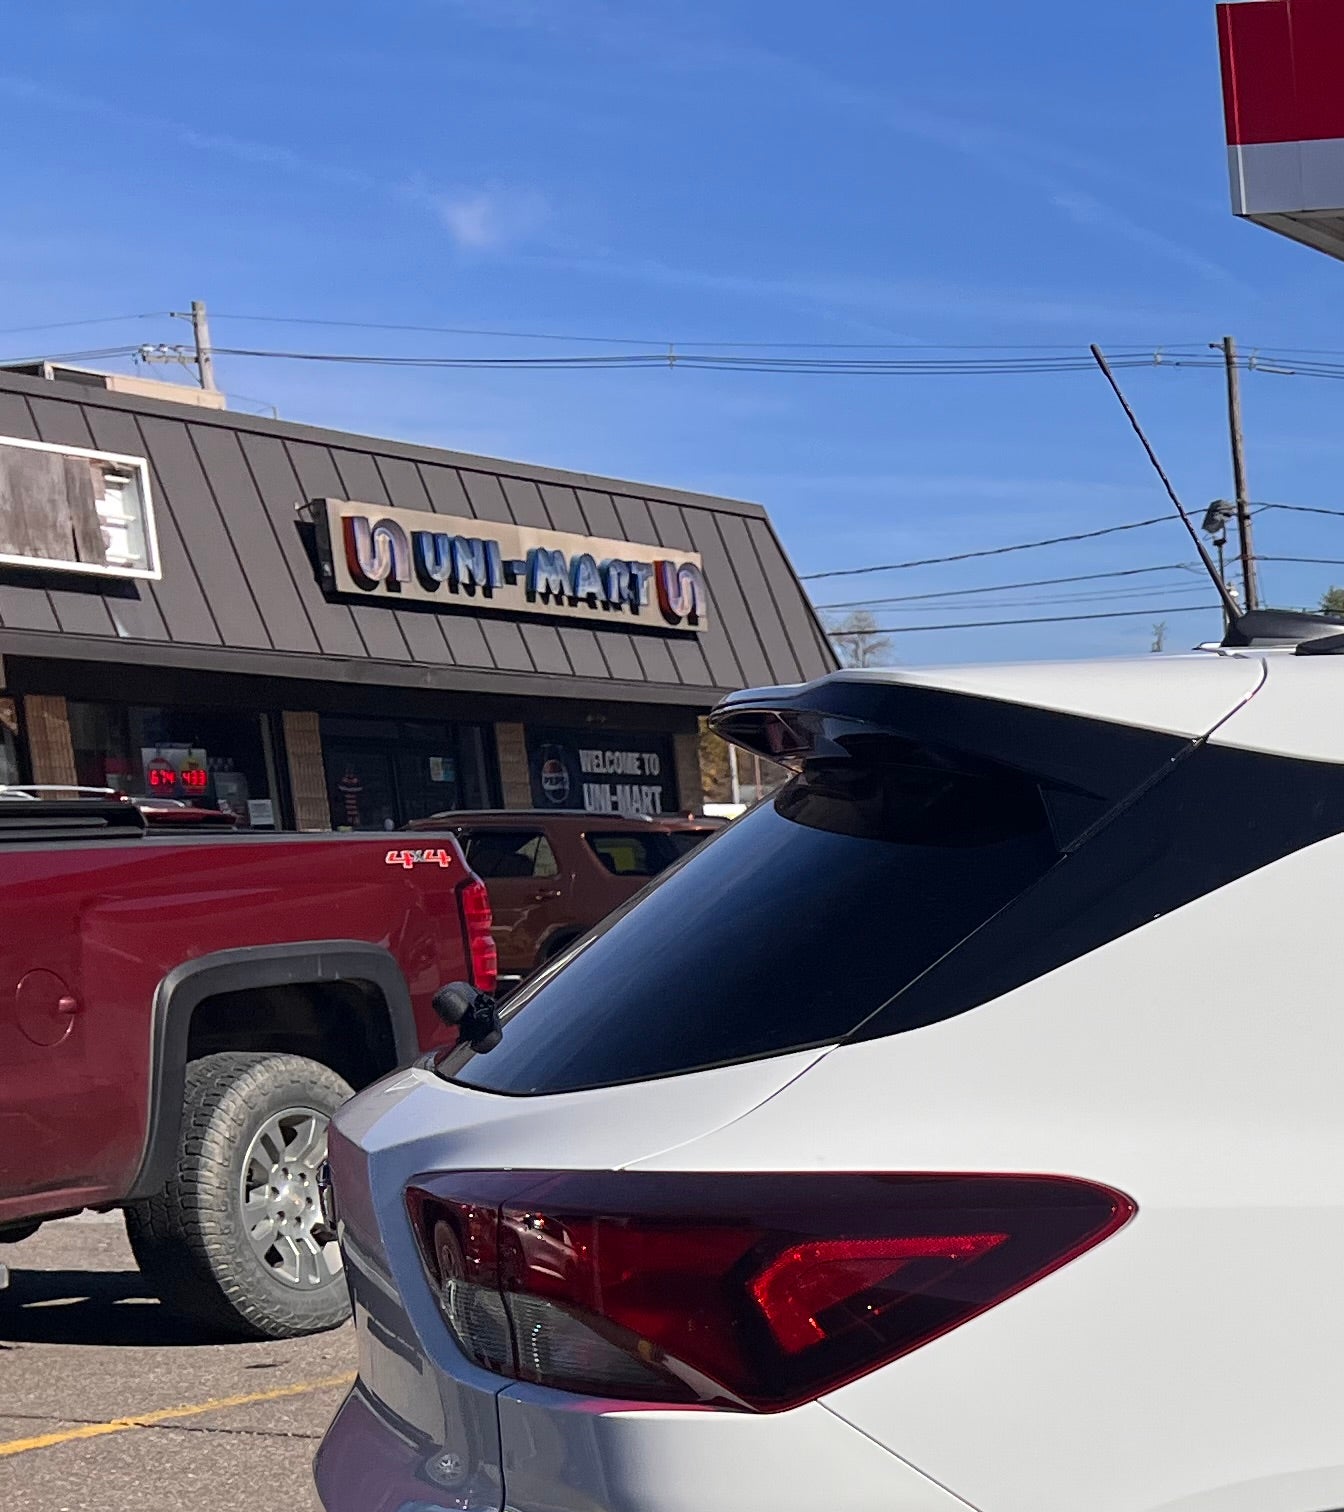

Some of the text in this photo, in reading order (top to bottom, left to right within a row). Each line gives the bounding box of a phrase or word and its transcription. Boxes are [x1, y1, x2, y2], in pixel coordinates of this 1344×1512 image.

[411, 530, 653, 607] UNI-MART
[579, 749, 660, 776] WELCOME TO
[583, 783, 662, 815] UNI-MART
